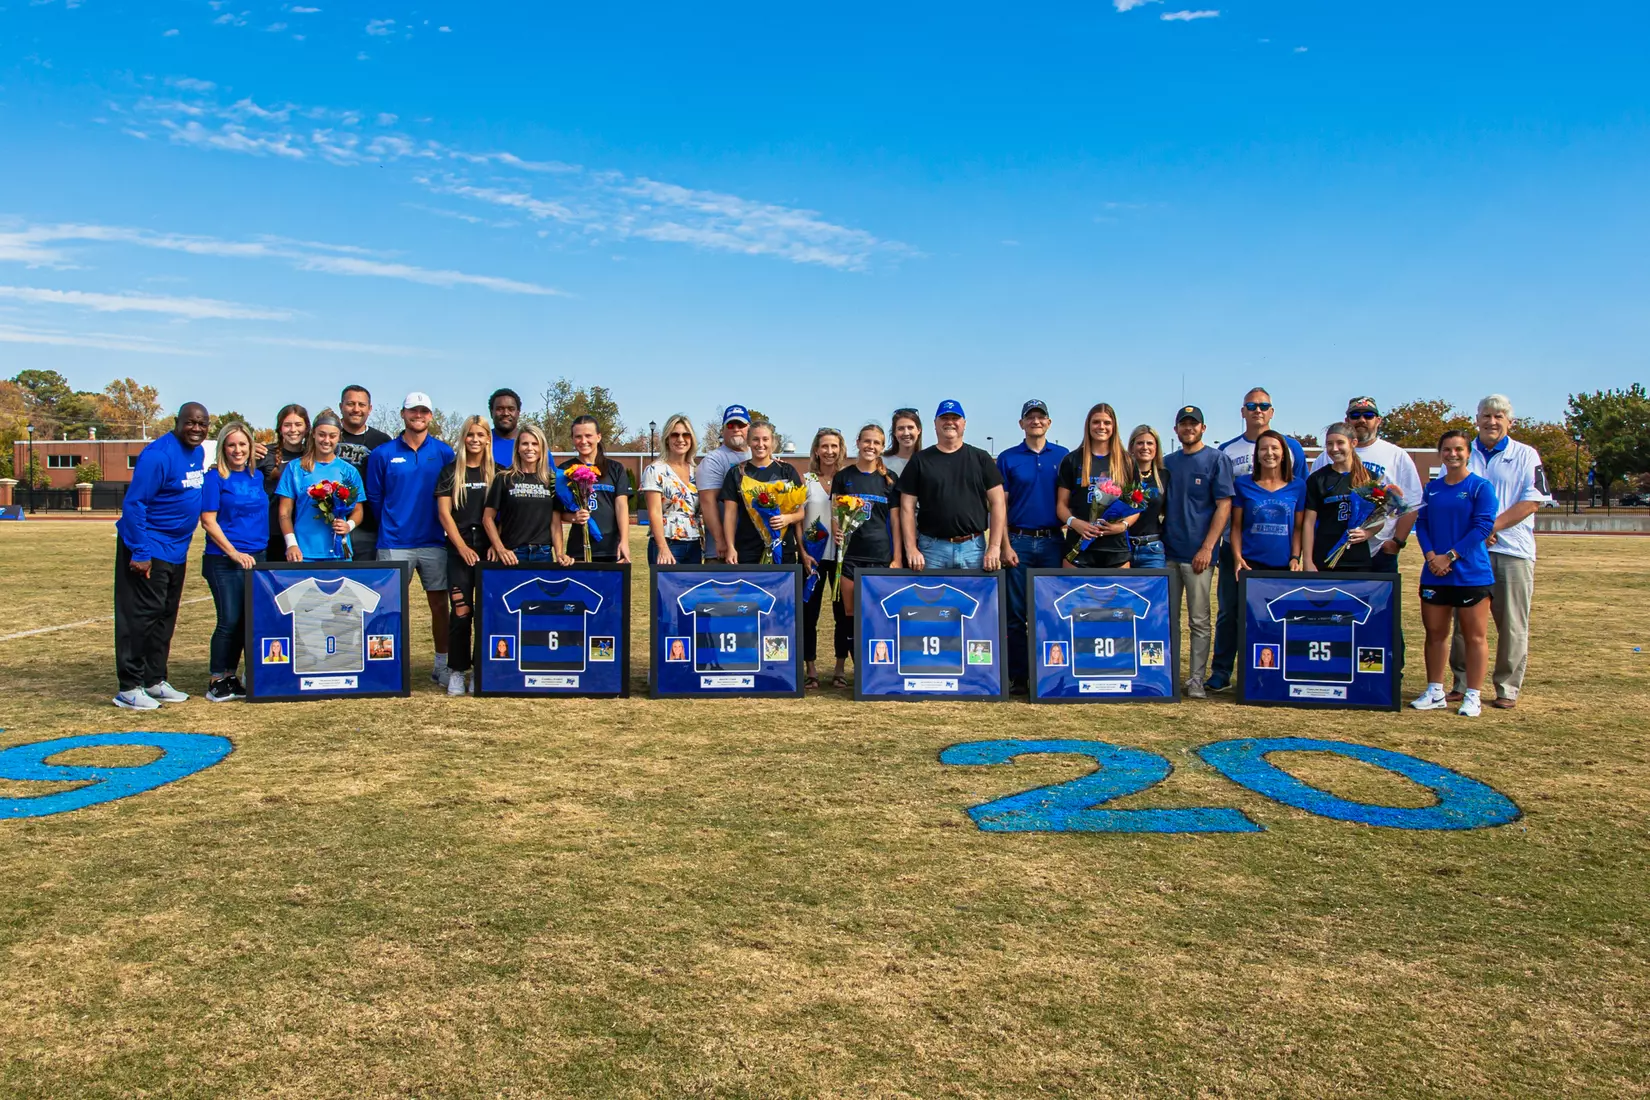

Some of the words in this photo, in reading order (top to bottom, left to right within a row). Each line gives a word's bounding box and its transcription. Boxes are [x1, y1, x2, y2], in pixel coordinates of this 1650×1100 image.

[339, 445, 364, 464] MT
[326, 635, 336, 655] 0
[548, 631, 559, 651] 6
[719, 633, 737, 653] 13
[922, 636, 940, 656] 19
[1094, 637, 1115, 657] 20
[1309, 641, 1331, 661] 25
[939, 736, 1522, 833] 20
